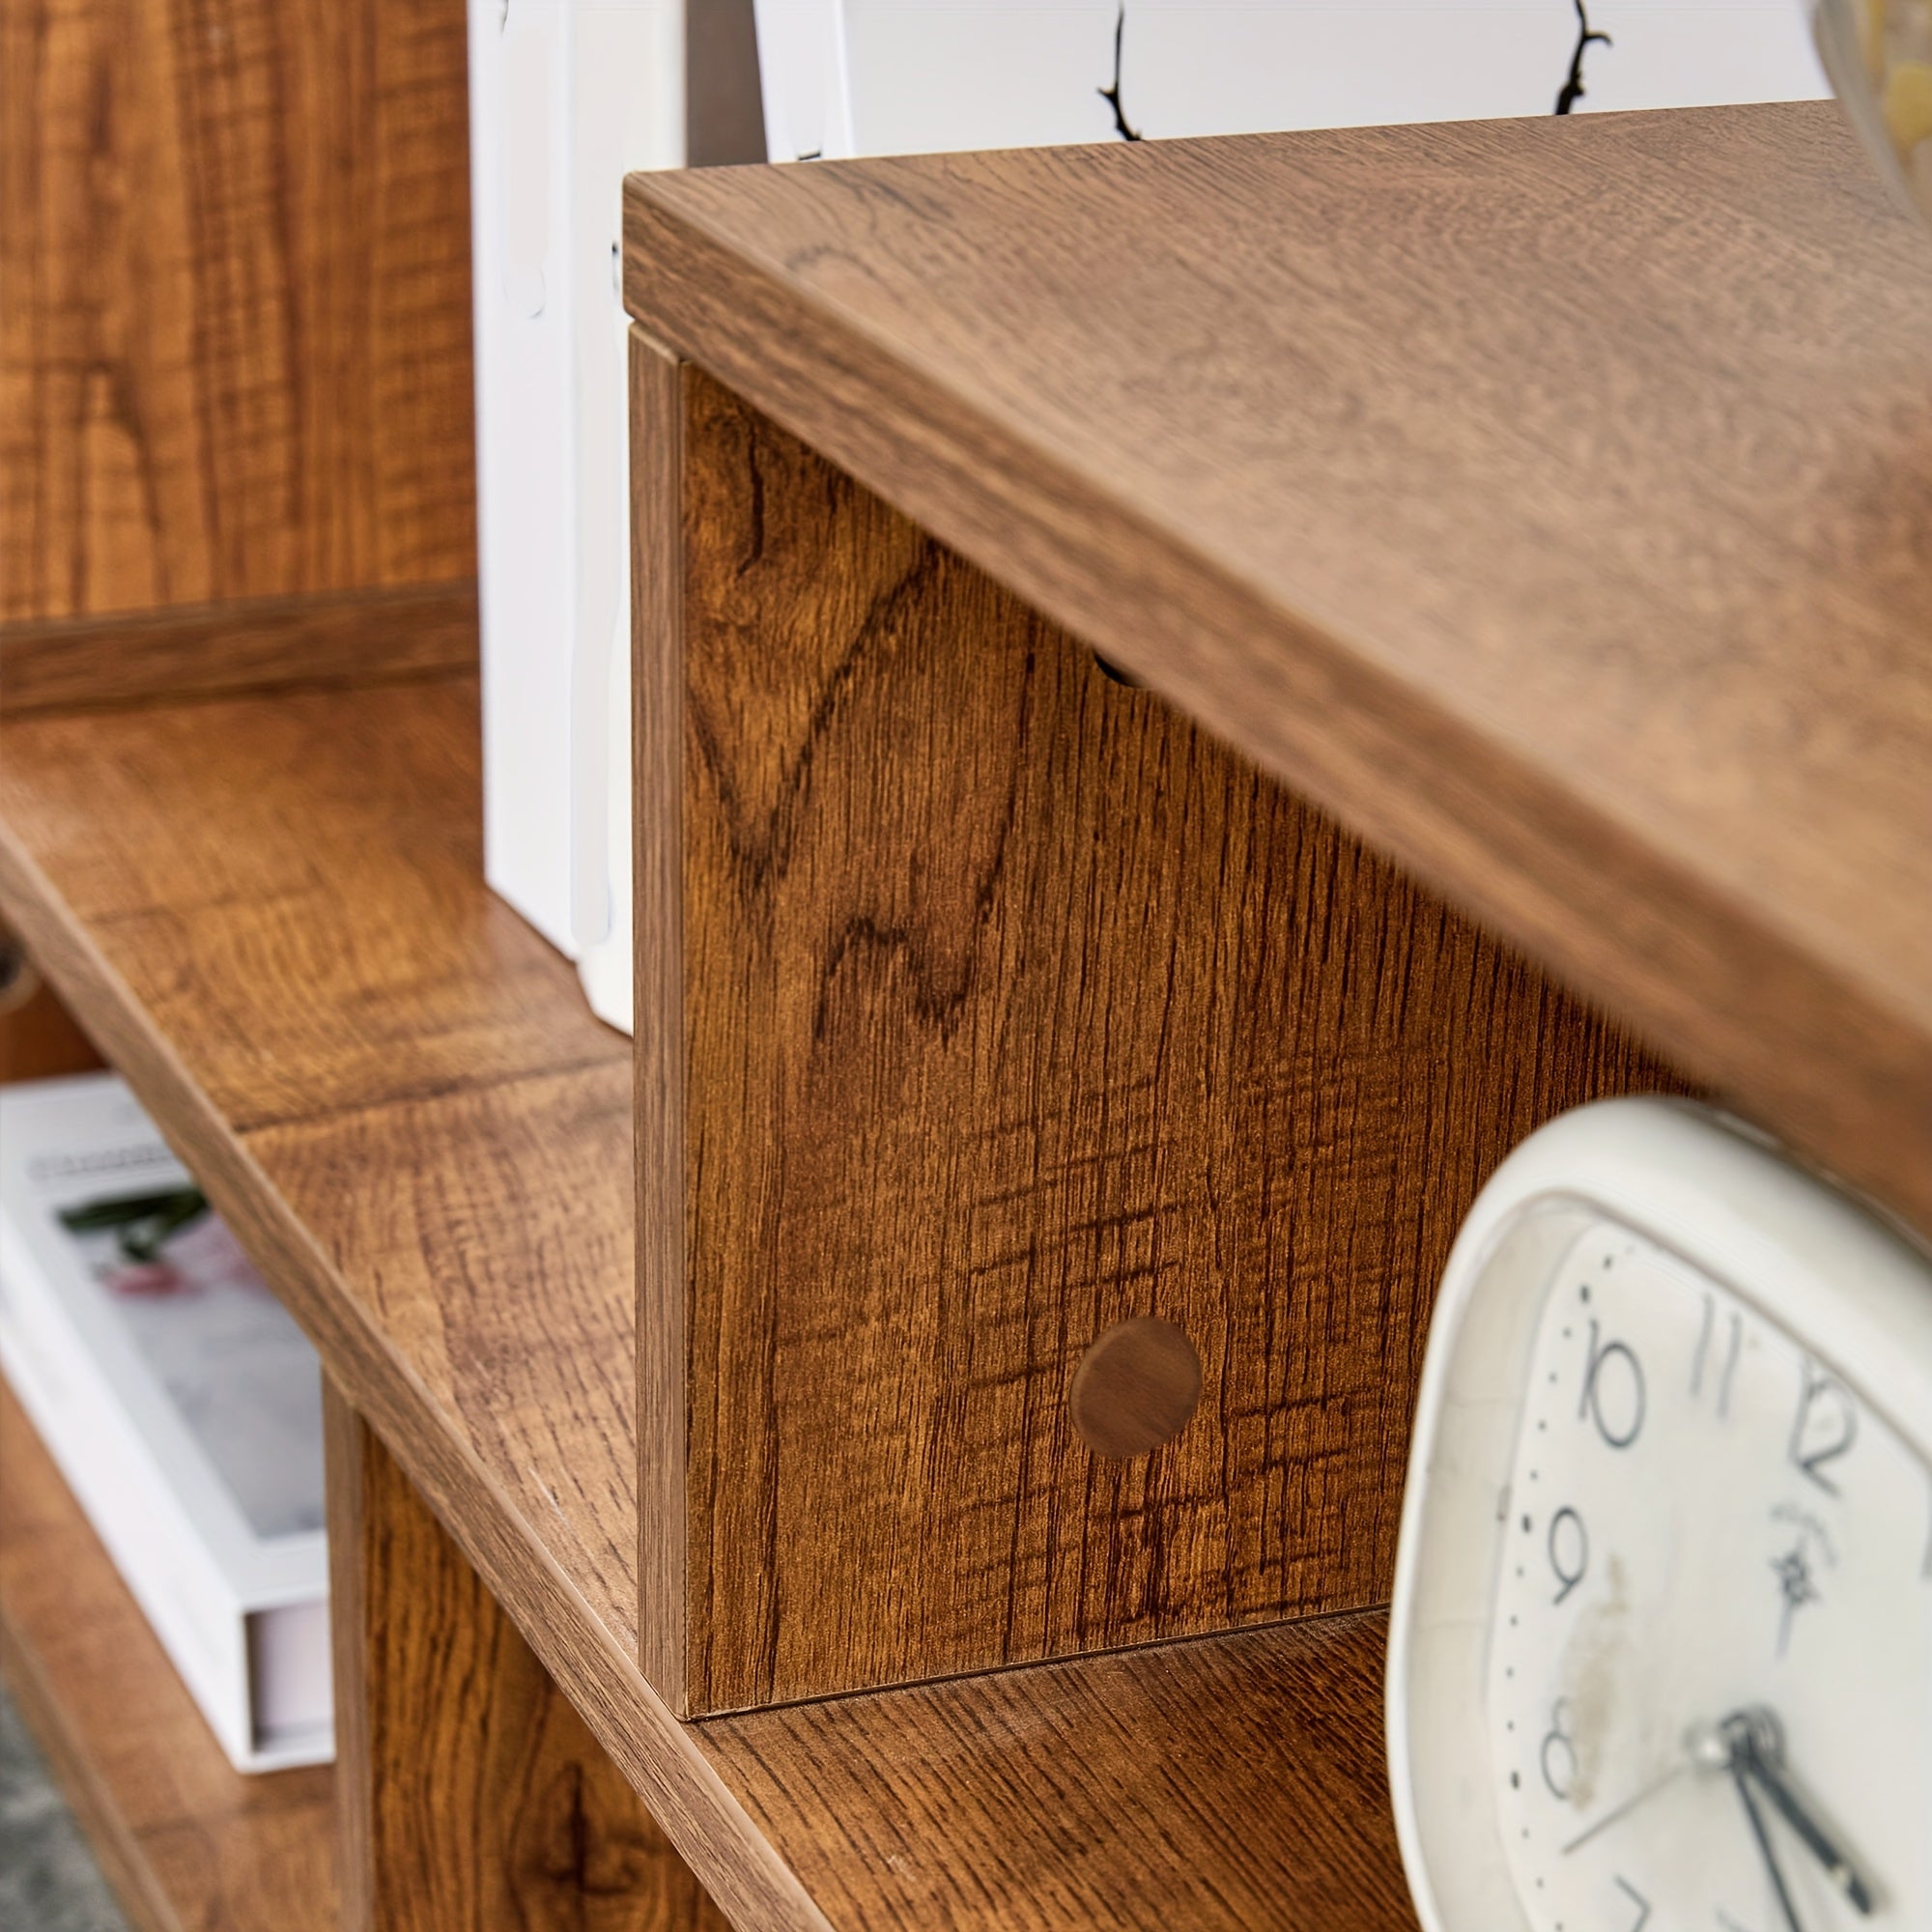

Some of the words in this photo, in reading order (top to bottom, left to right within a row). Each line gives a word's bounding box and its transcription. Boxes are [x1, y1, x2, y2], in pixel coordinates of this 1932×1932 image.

[1579, 1317, 1643, 1448] 10
[1790, 1355, 1857, 1496] 12
[1548, 1506, 1587, 1605] 9
